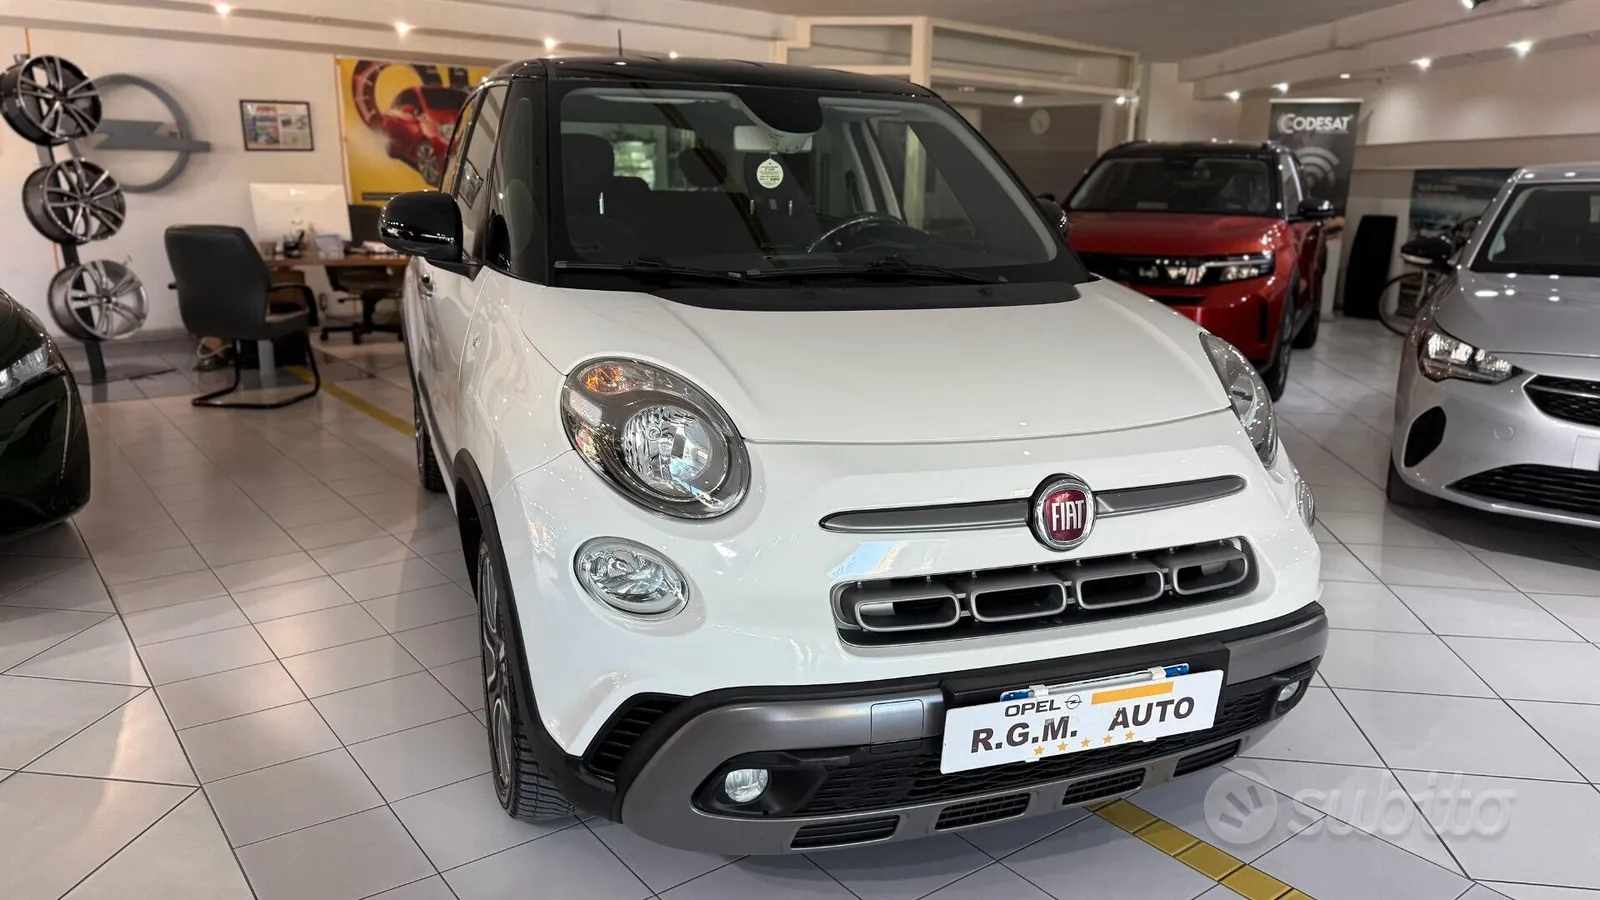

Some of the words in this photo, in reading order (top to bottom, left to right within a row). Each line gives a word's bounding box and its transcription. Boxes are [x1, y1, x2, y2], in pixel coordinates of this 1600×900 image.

[1277, 113, 1354, 133] CODESAT
[1051, 500, 1084, 531] FIAT
[1004, 699, 1061, 718] OPEL
[970, 716, 1078, 754] R.G.M.
[1108, 696, 1195, 732] AUTO
